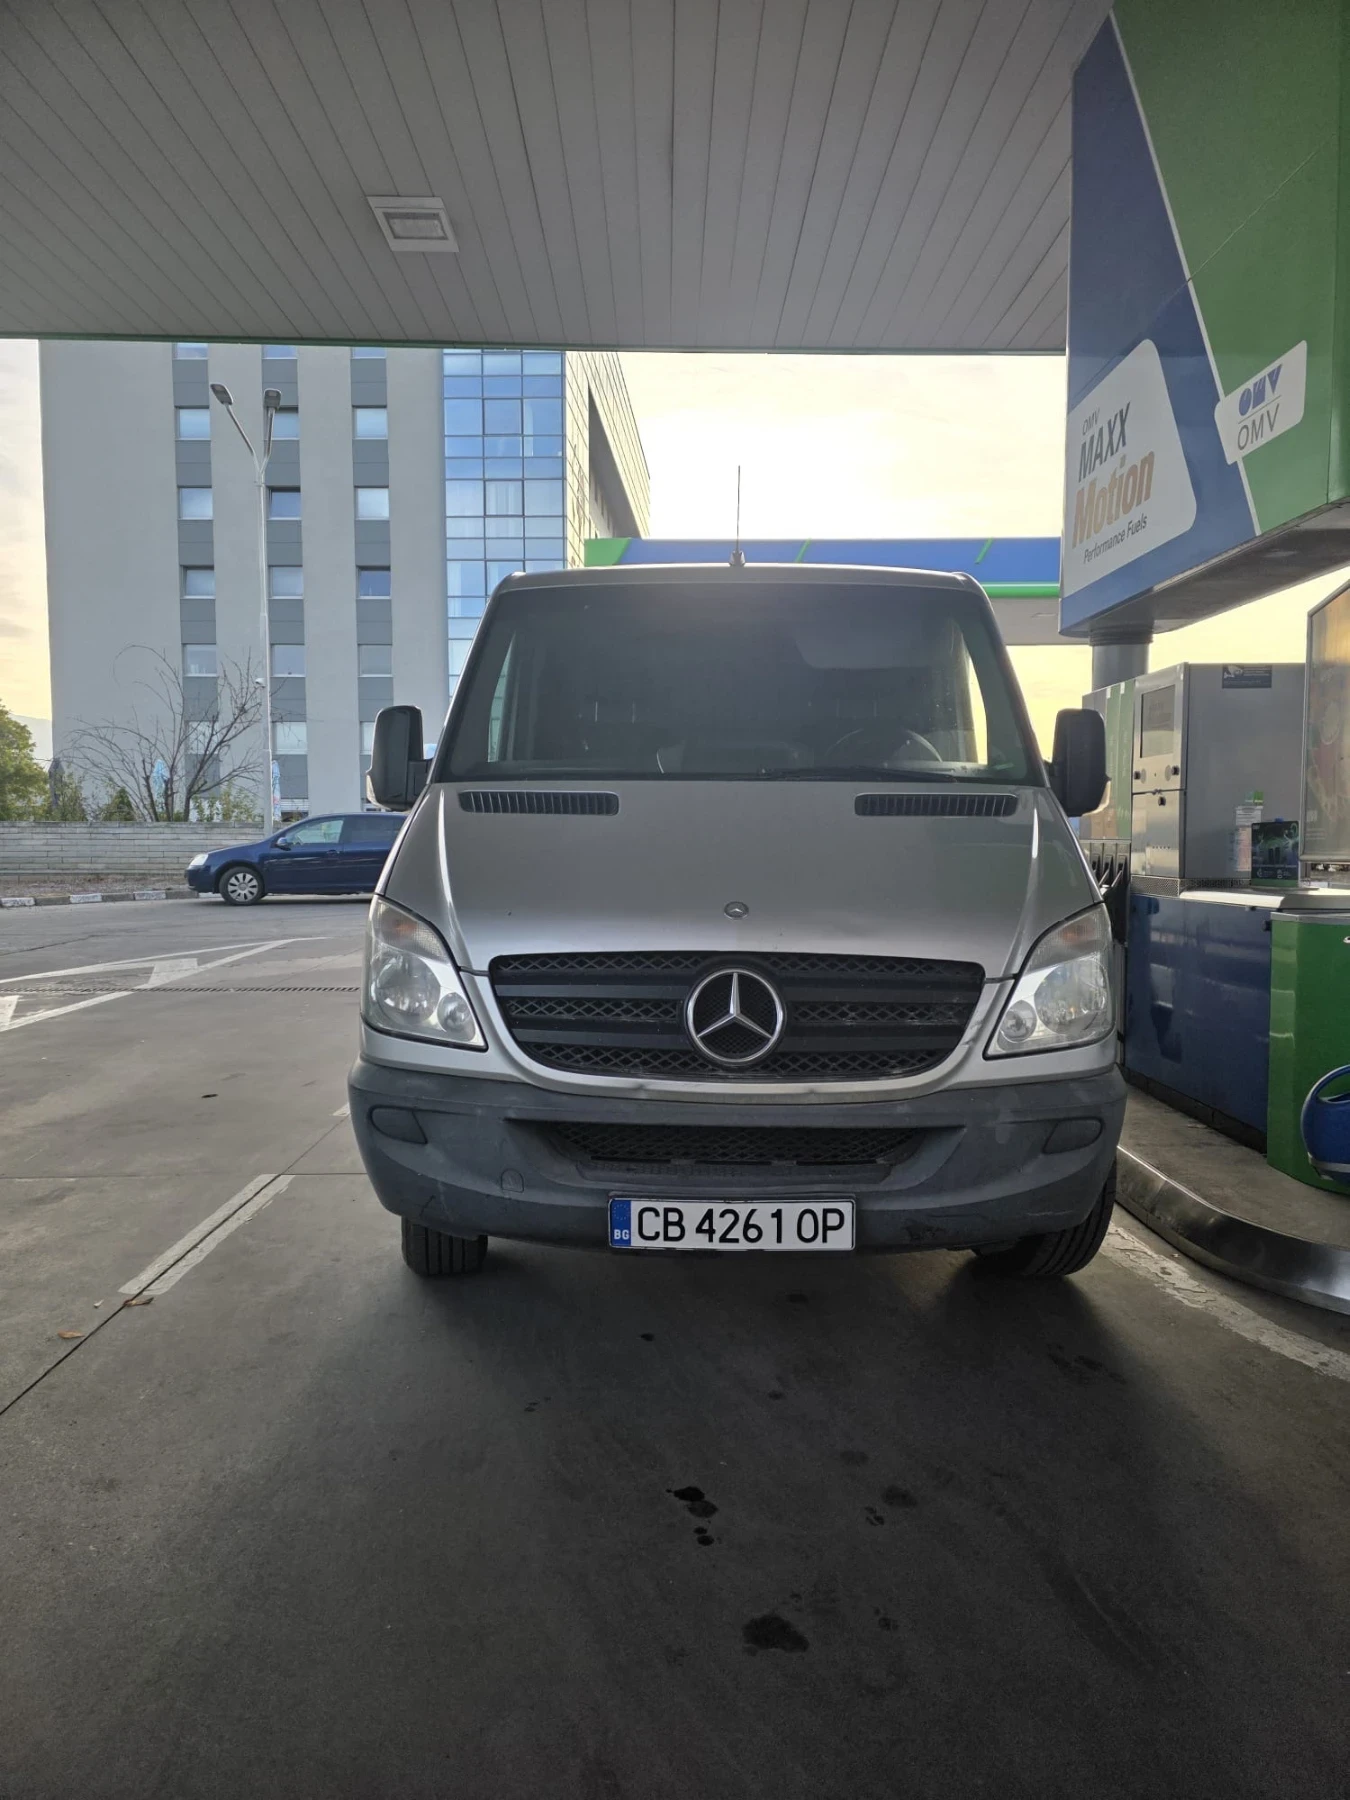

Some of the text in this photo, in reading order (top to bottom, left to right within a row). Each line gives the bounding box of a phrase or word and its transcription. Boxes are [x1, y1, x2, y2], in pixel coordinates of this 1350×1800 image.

[1078, 401, 1131, 483] MAXX
[1082, 408, 1100, 436] OMV
[1237, 403, 1280, 451] OMV
[1072, 450, 1155, 549] Motion
[1083, 513, 1148, 564] Performance Fuels
[613, 1229, 630, 1240] BG
[637, 1207, 845, 1244] CB 4261 OP
